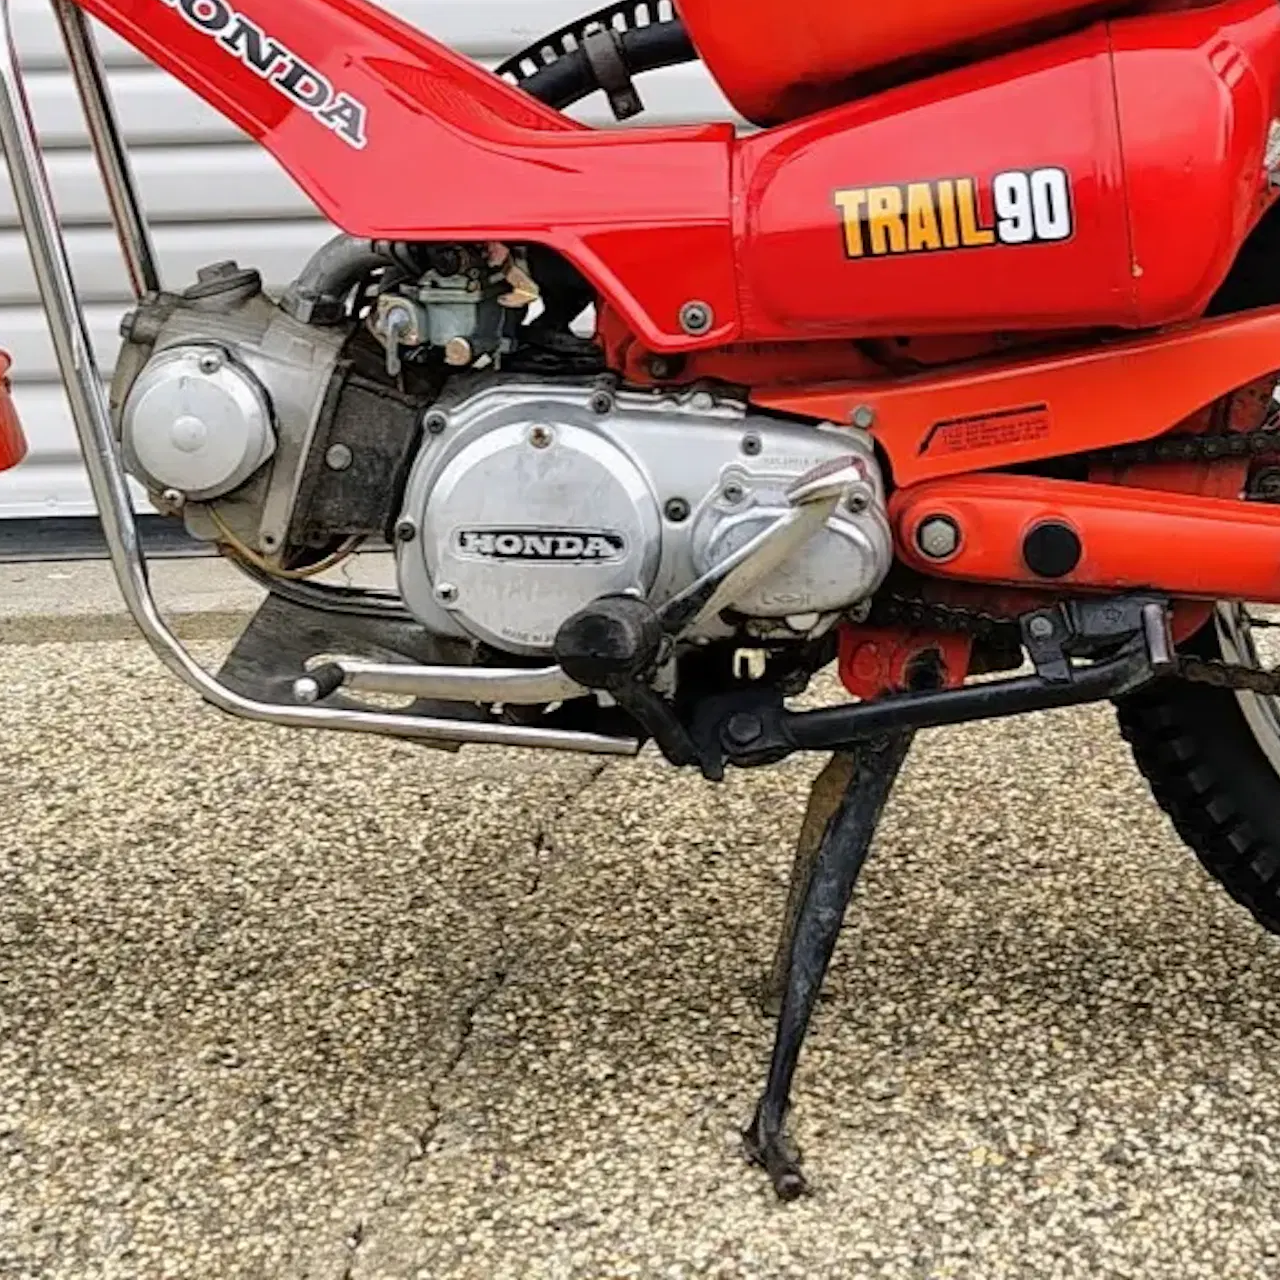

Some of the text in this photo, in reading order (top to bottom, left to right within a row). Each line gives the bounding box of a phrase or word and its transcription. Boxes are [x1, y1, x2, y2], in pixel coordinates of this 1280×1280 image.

[833, 167, 1071, 259] TRAIL 90
[462, 531, 618, 558] HONDA
